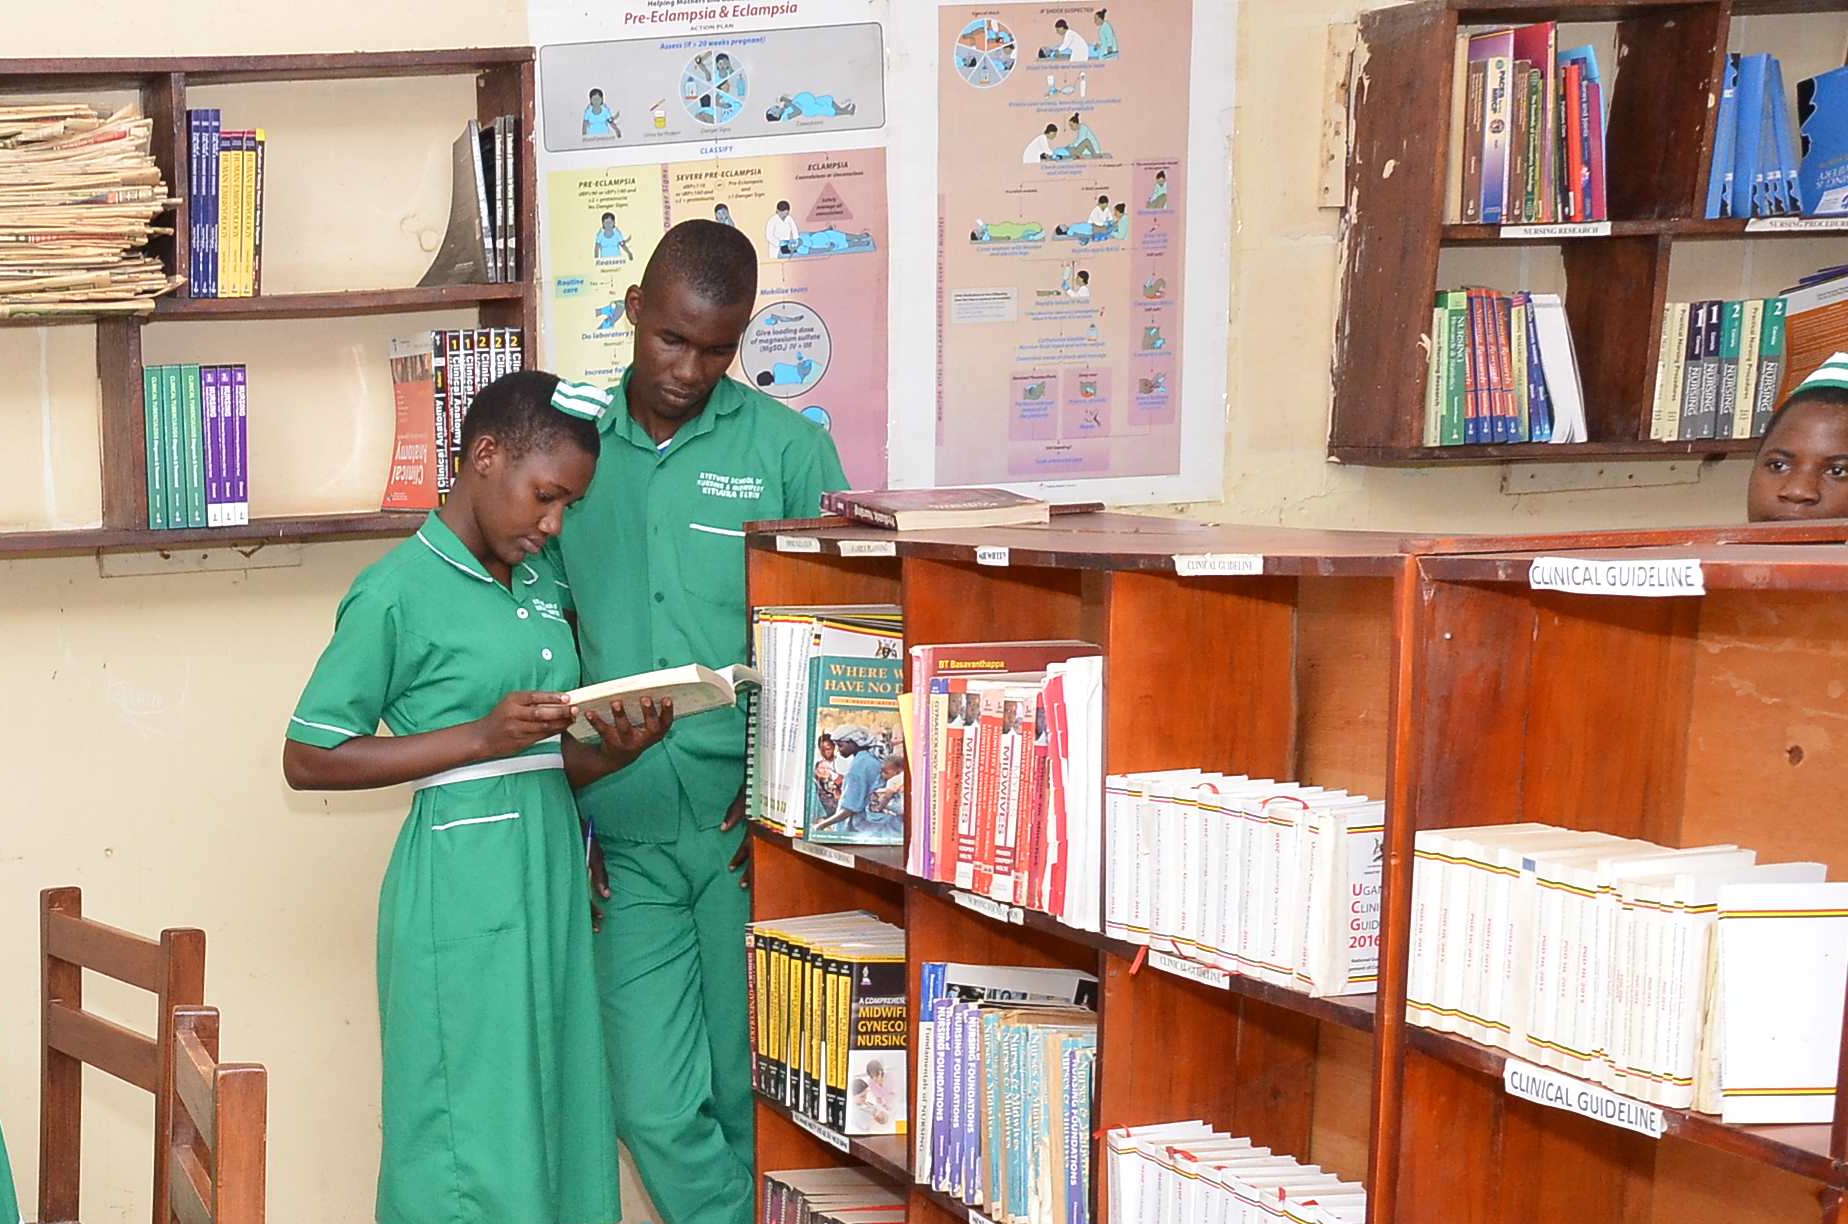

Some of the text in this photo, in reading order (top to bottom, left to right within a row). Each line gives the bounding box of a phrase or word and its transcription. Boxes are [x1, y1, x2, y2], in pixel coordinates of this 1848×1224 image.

[624, 1, 799, 27] Pre-Eclampsia & Eclampsia
[700, 145, 734, 155] CLASSIFY
[676, 167, 762, 181] SEVERE PRE-ECLAMPSIA
[807, 161, 849, 171] ECLAMPSIA
[578, 177, 636, 189] PRE-ECLAMPSIA
[1558, 226, 1599, 234] RESEARCH
[1709, 306, 1719, 324] 1
[1732, 304, 1740, 318] 2
[1774, 302, 1783, 316] 2
[452, 340, 457, 349] 1
[479, 337, 486, 347] 2
[495, 337, 502, 347] 2
[510, 336, 518, 346] 2
[465, 355, 474, 398] Clinical
[1704, 363, 1716, 412] NURSING
[1723, 365, 1736, 414] NURSING
[1760, 363, 1778, 412] NURSING
[451, 356, 462, 444] Clinical Anatomy
[436, 400, 445, 488] Clinical Anatomy
[1187, 560, 1253, 571] CLINICAL GUIDELINE
[1532, 566, 1695, 587] CLINICAL GUIDELINE
[830, 664, 888, 679] WHERE
[824, 679, 892, 693] HAVE NO
[961, 737, 974, 824] MIDWIVES
[997, 745, 1010, 835] MIDWIVES
[936, 1006, 946, 1122] NURSING FOUNDATIONS
[967, 1016, 977, 1134] NURSING FOUNDATIONS
[1511, 1071, 1657, 1132] CLINICAL GUIDELINE
[1070, 1112, 1082, 1186] FOUNDATIONS
